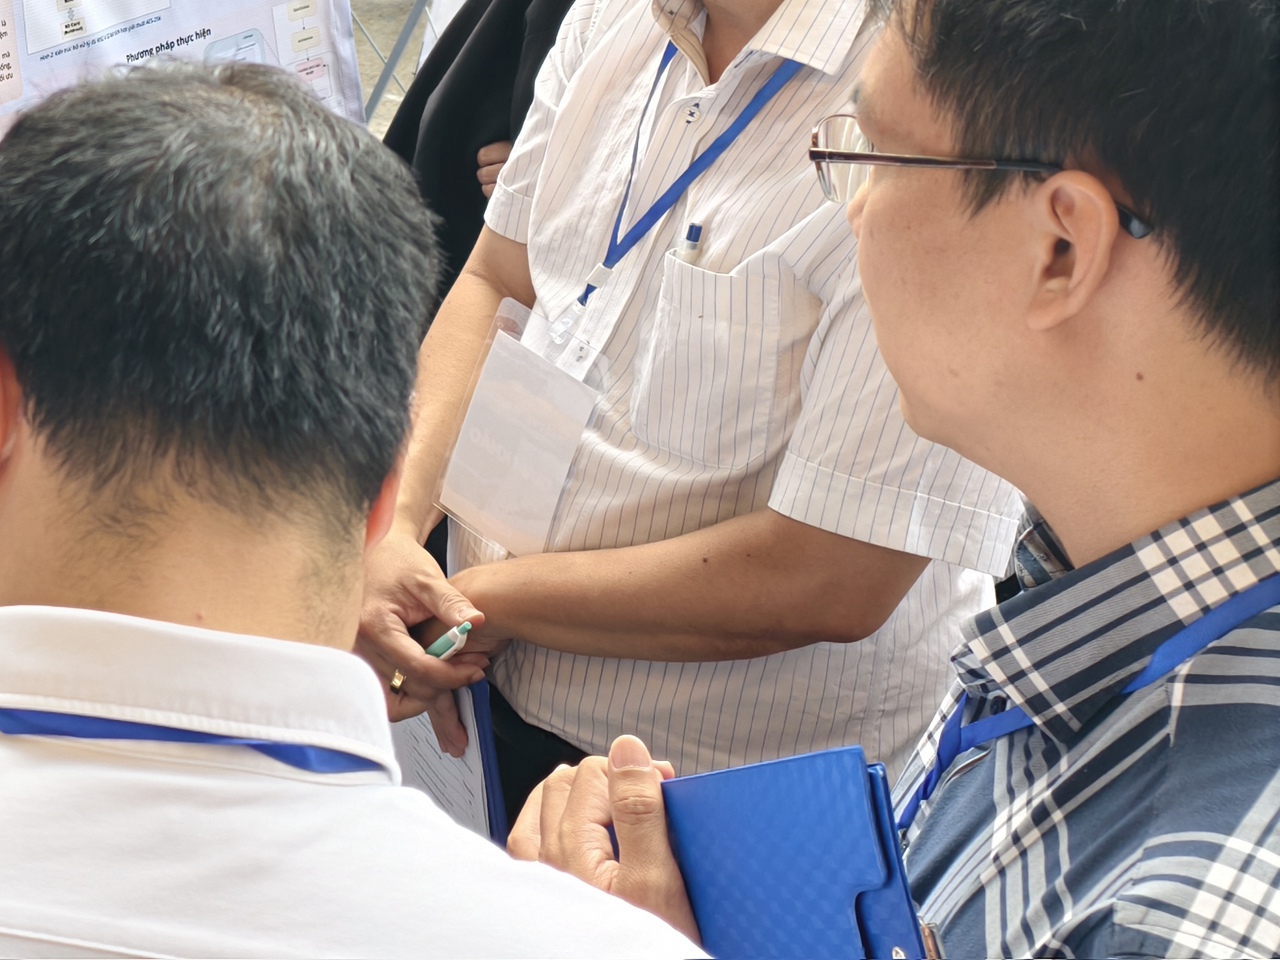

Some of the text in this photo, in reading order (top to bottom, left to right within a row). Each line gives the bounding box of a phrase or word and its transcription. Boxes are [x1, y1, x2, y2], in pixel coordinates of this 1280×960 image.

[126, 26, 212, 63] Phương pháp thực hiện
